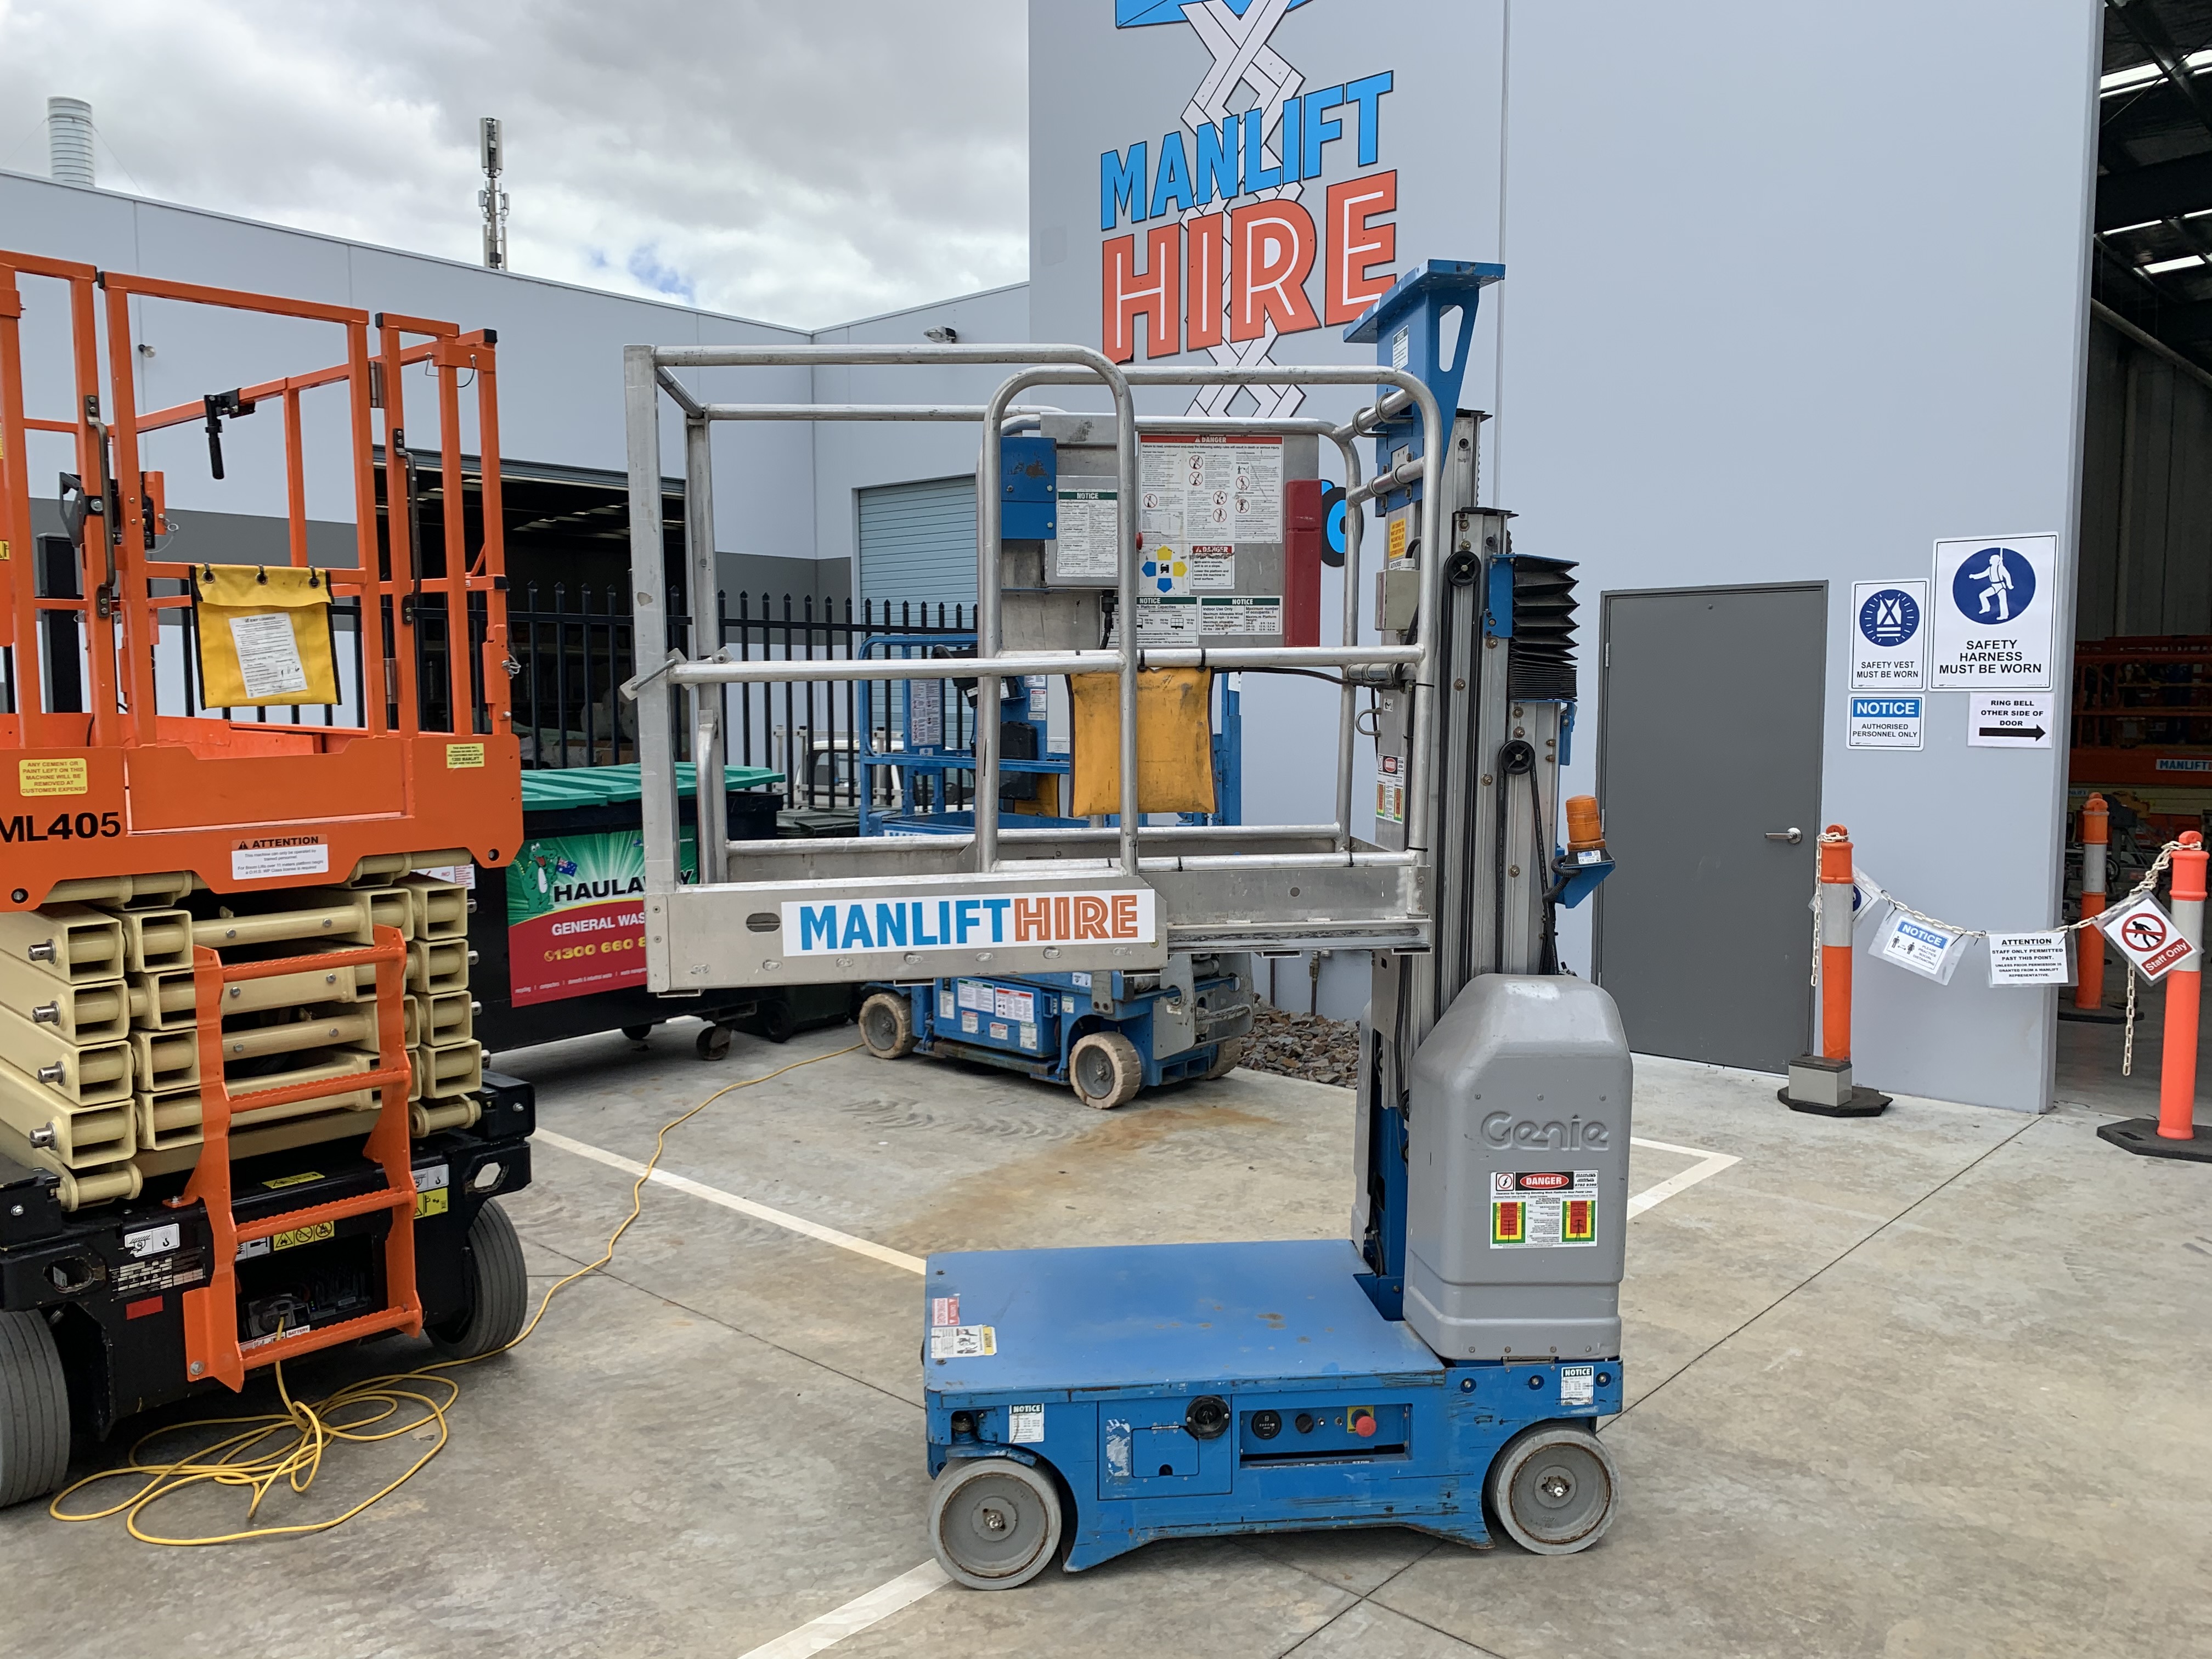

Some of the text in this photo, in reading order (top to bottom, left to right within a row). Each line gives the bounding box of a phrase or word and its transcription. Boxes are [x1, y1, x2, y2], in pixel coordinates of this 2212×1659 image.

[1101, 70, 1393, 231] MANLIFT
[1102, 169, 1397, 364] HIRE
[1966, 640, 2017, 650] SAFETY
[1960, 652, 2023, 662] HARNESS
[1939, 663, 2041, 674] MUST BE WORN
[1857, 702, 1915, 715] NOTICE
[0, 812, 121, 843] ML405
[252, 836, 319, 848] ATTENTION
[554, 870, 694, 902] HAULAY
[551, 912, 645, 936] GENERAL WAS
[1902, 924, 1942, 946] NOTICE
[555, 936, 646, 960] 1300 660 8
[1918, 947, 1937, 958] PRACTICE
[1922, 945, 1937, 953] PLEASE
[1912, 954, 1935, 966] DISTANCING
[2145, 942, 2188, 971] Staff Only
[1481, 1111, 1609, 1150] Genie
[1526, 1176, 1562, 1185] DANGER
[1565, 1368, 1590, 1376] NOTICE
[1013, 1404, 1041, 1413] NOTICE
